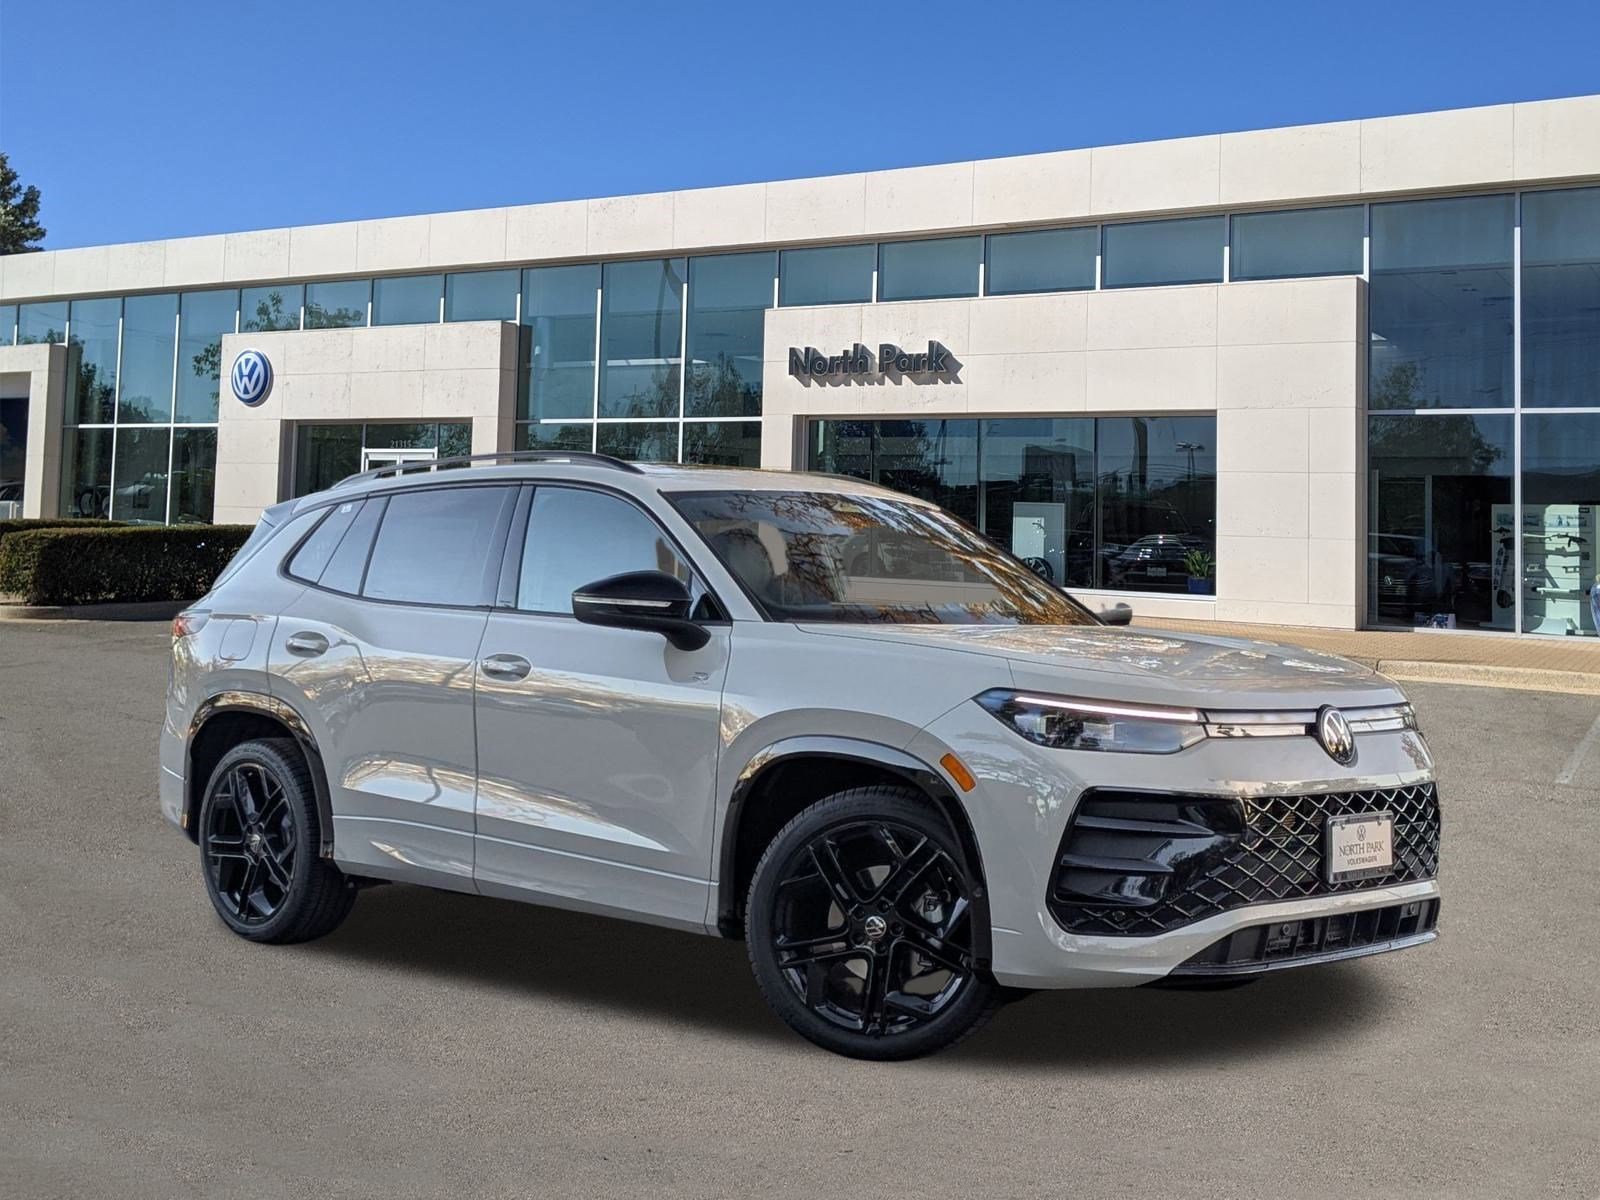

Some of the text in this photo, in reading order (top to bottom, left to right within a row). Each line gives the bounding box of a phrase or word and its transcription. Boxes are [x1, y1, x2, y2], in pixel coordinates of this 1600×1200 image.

[788, 340, 948, 376] North Park
[232, 350, 268, 403] VW
[1339, 840, 1385, 857] NORTH PARK
